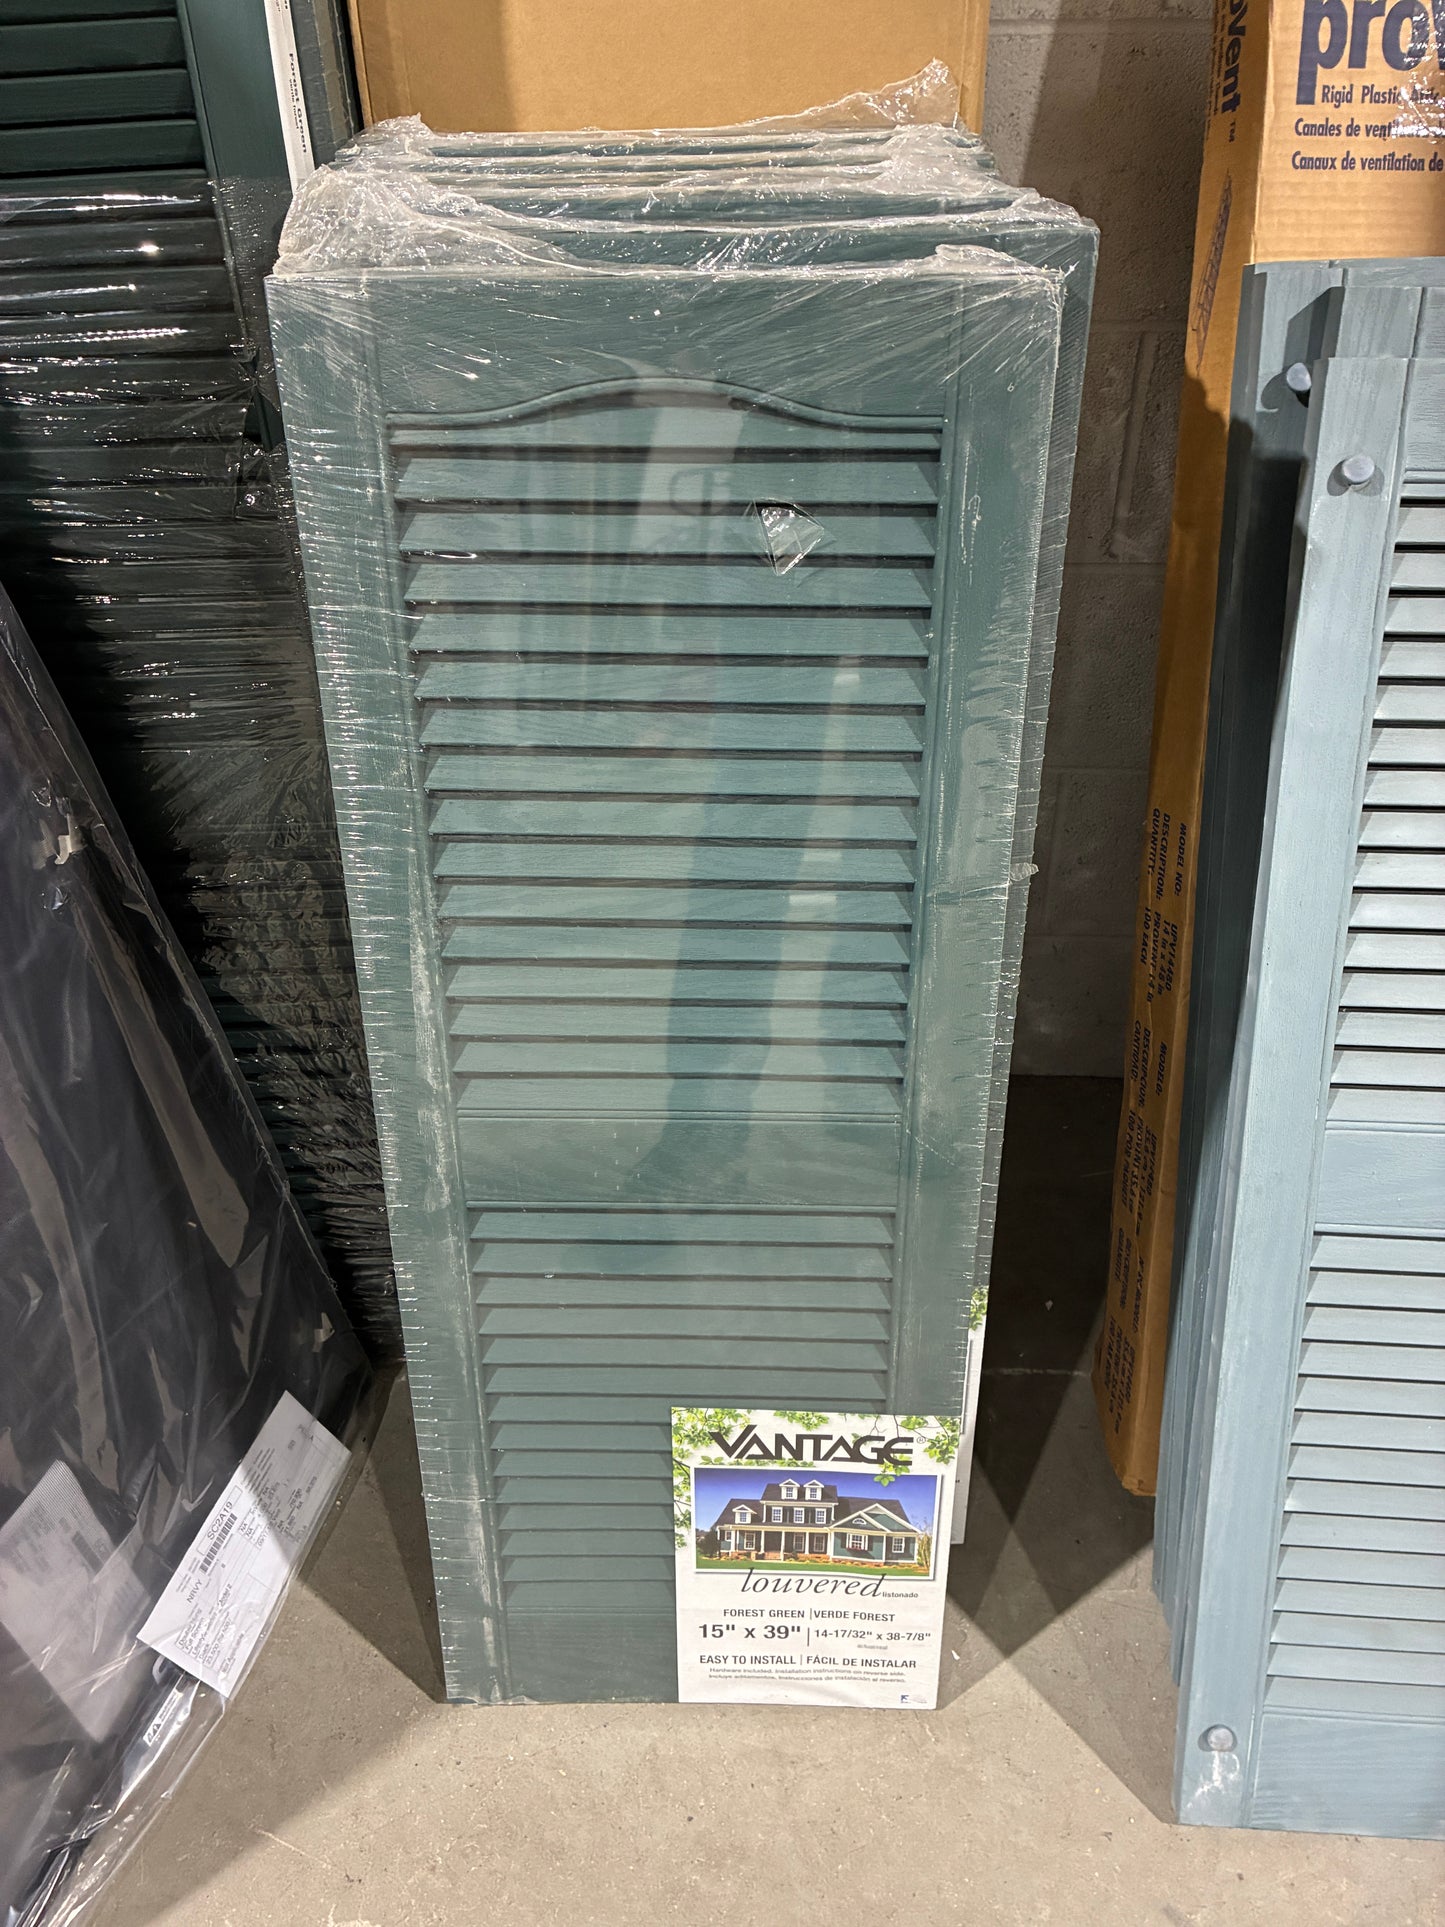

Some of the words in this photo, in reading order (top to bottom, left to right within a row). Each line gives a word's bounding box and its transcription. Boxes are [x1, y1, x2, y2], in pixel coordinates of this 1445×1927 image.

[1322, 84, 1353, 109] Rigid
[1294, 118, 1341, 137] Canales
[1345, 118, 1360, 137] de
[1292, 151, 1336, 171] Canaux
[1341, 151, 1356, 171] de
[1361, 153, 1425, 171] ventilation
[1429, 152, 1443, 171] de
[1147, 808, 1160, 875] QUANTITY:
[1156, 812, 1171, 900] DESCRIPTION:
[1177, 822, 1187, 867] MODEL
[1174, 871, 1183, 896] NO:
[1140, 932, 1149, 965] EACH
[1150, 911, 1161, 971] PROVENT
[1155, 1041, 1168, 1096] MODELO:
[709, 1425, 914, 1466] VANTAGE
[207, 1501, 233, 1541] SC2A19
[741, 1568, 887, 1598] louvered
[723, 1608, 765, 1618] FOREST
[769, 1609, 805, 1619] GREEN
[813, 1610, 850, 1619] VERDE
[853, 1611, 896, 1622] FOREST
[698, 1624, 736, 1639] 15"
[744, 1627, 756, 1639] x
[763, 1625, 801, 1640] 39"
[815, 1629, 873, 1640] 14-17/32"
[876, 1632, 883, 1641] x
[886, 1631, 931, 1641] 38-7/8"
[699, 1655, 729, 1665] EASY
[731, 1655, 747, 1665] TO
[750, 1656, 796, 1665] INSTALL
[806, 1654, 839, 1666] FÁCIL
[842, 1658, 857, 1667] DE
[860, 1659, 917, 1669] INSTALAR
